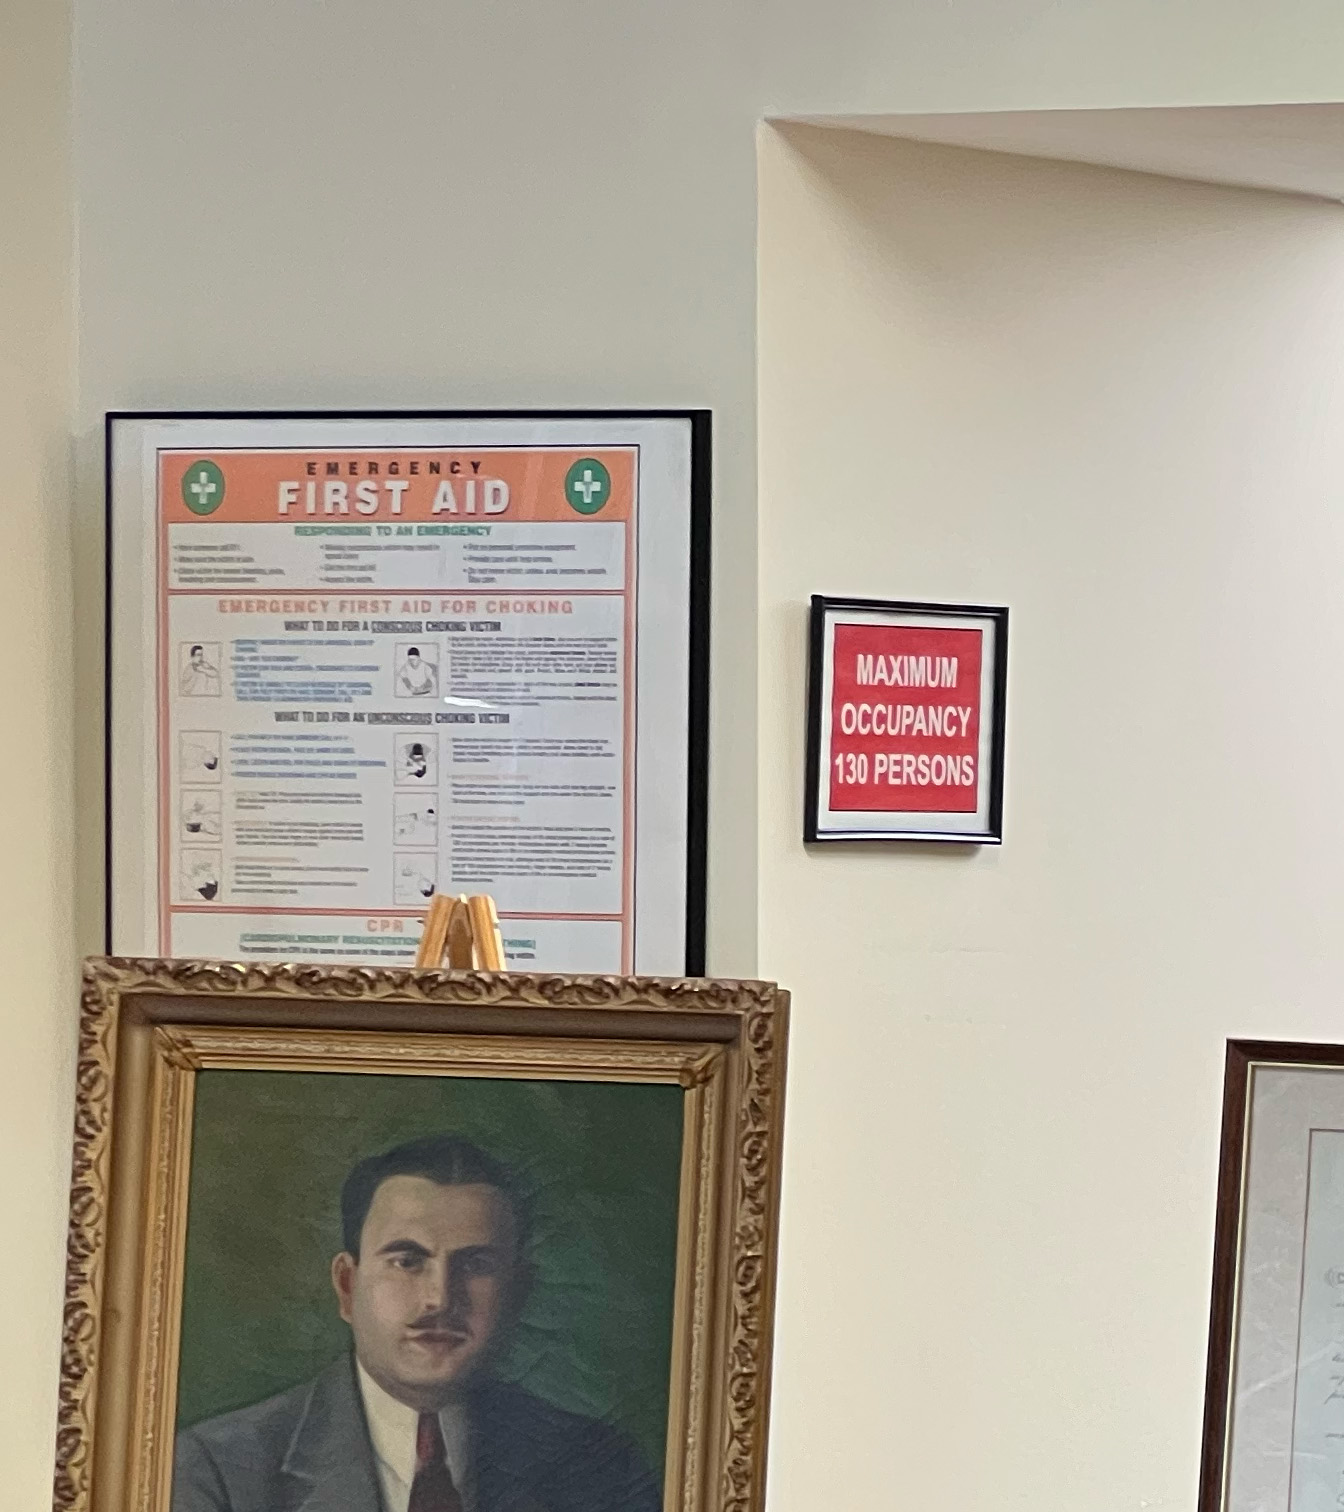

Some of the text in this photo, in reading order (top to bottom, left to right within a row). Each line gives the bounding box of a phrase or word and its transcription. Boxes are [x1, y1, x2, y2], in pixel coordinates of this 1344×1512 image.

[306, 460, 482, 476] EMERGENCY
[278, 479, 511, 515] FIRST AID
[376, 525, 393, 536] TO
[396, 525, 413, 536] AN
[416, 525, 492, 537] EMERGENCY
[217, 599, 573, 615] EMERGENCY FIRST AID FOR CHOKING
[312, 621, 324, 632] TO
[341, 621, 361, 632] FOR
[426, 621, 467, 632] CHOKING
[856, 654, 958, 688] MAXIMUM
[841, 702, 972, 737] OCCUPANCY
[834, 752, 975, 787] 130 PERSONS
[366, 919, 404, 933] CPR
